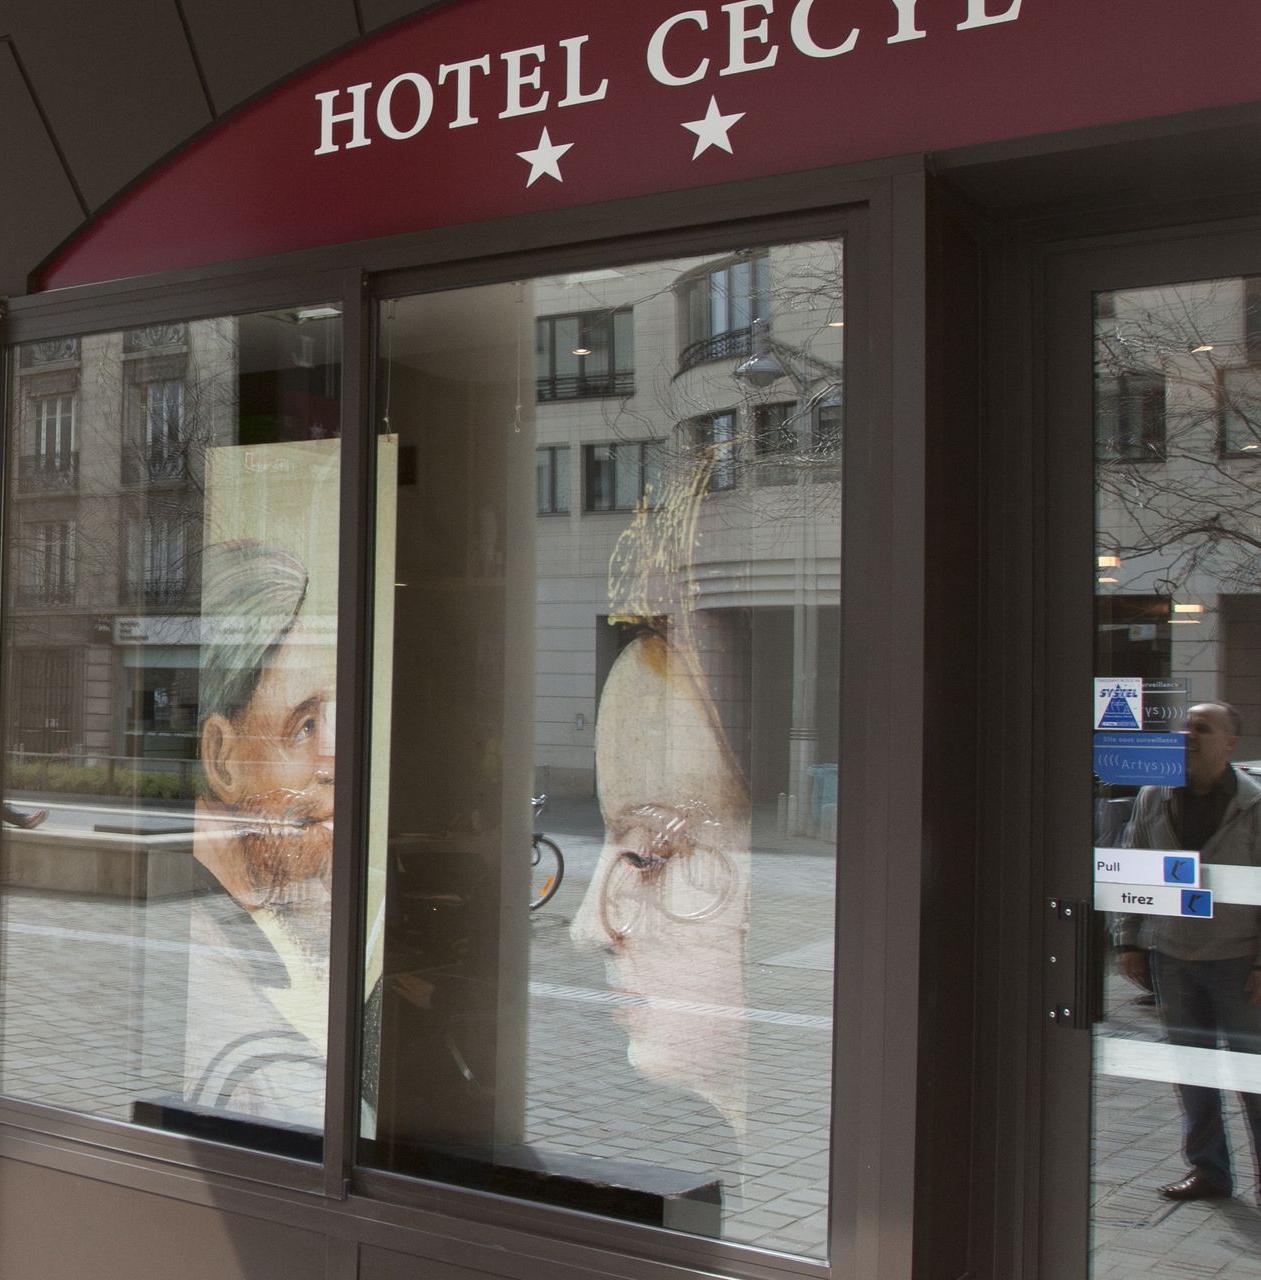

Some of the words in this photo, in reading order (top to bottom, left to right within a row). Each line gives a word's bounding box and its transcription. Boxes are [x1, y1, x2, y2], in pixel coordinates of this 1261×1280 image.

[314, 34, 609, 156] HOTEL
[1099, 688, 1139, 698] SYSTEL
[1097, 861, 1120, 872] Pull
[1122, 892, 1154, 905] tirez
